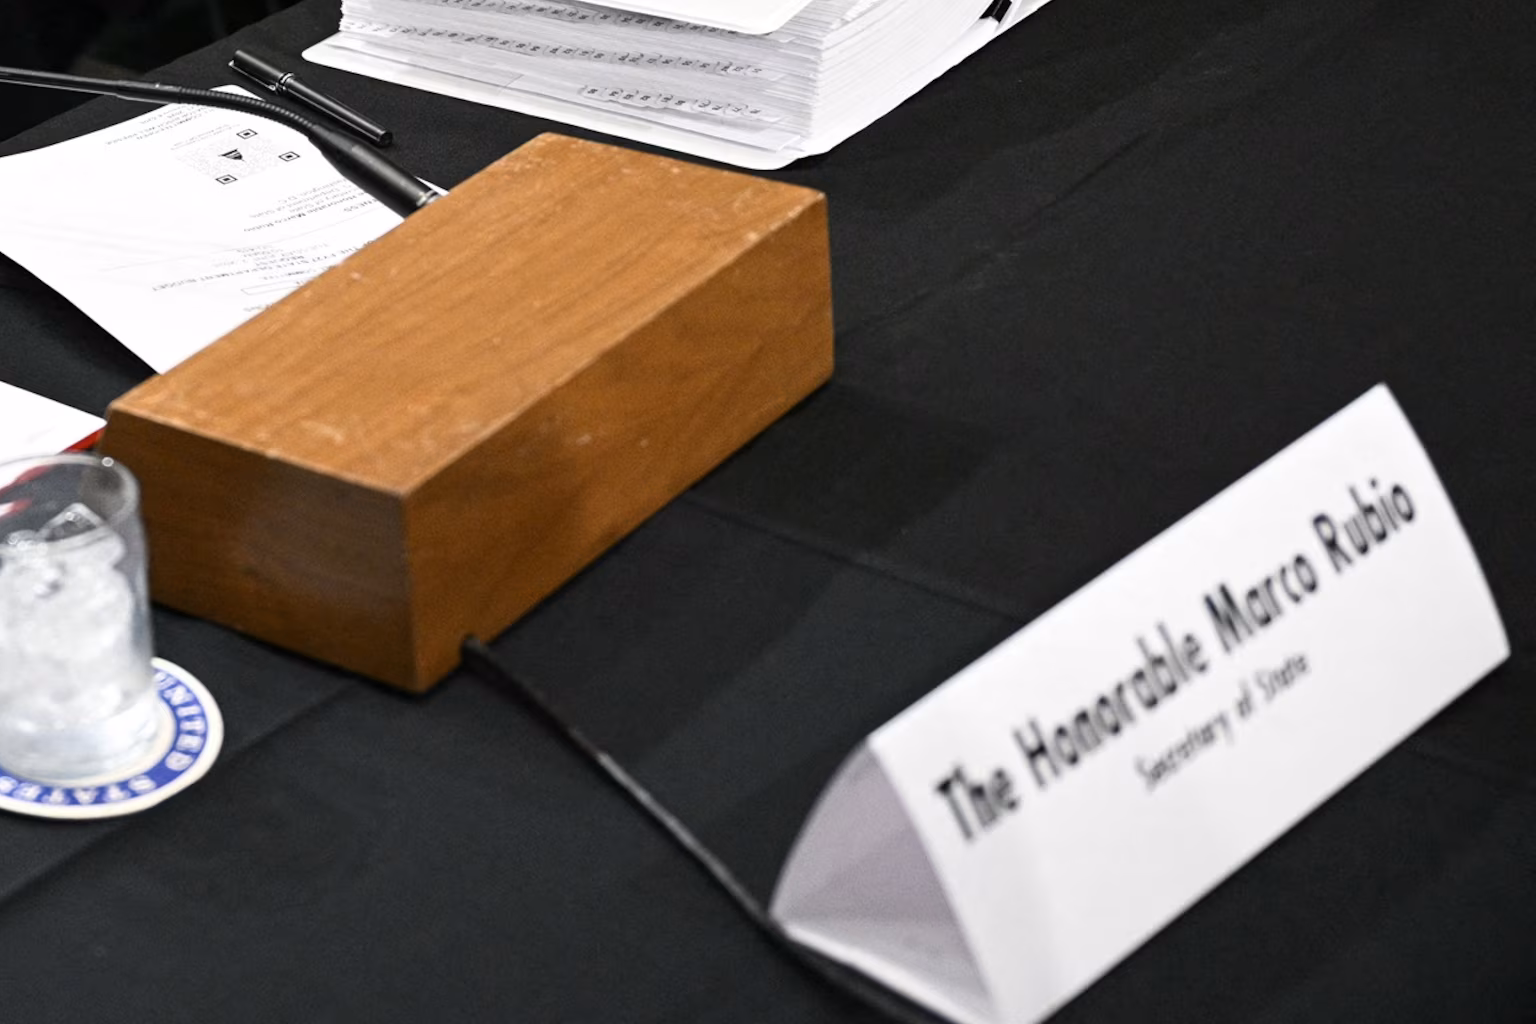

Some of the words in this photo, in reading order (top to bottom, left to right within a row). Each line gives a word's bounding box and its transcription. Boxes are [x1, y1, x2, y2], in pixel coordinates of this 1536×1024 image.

[935, 764, 1020, 843] The
[1012, 619, 1210, 790] Honorable
[1203, 582, 1319, 654] Marco
[1312, 476, 1416, 574] Rubio
[1134, 711, 1233, 794] Secretary
[1235, 680, 1257, 721] of
[1255, 653, 1311, 704] State
